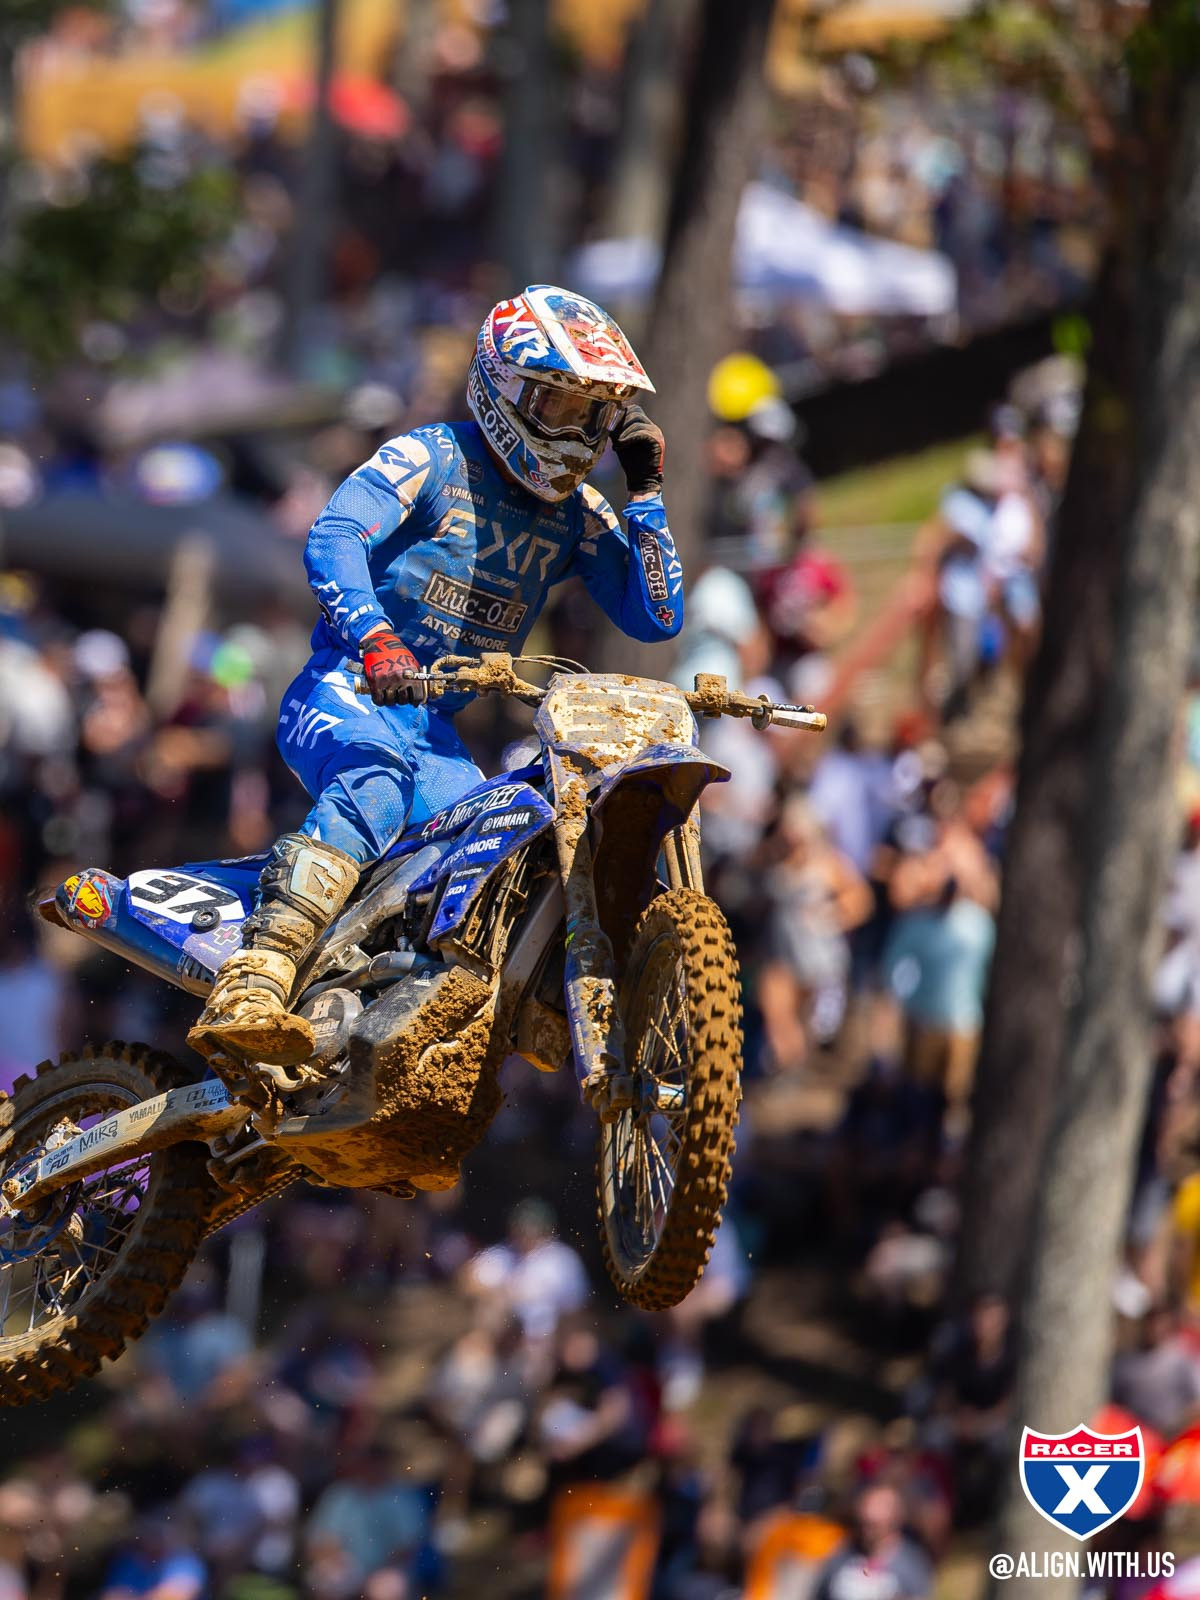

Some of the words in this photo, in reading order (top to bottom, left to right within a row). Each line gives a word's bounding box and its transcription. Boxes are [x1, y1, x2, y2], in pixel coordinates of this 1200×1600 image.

[451, 486, 485, 506] YAMAHA
[432, 507, 560, 582] FXR
[430, 580, 525, 629] Muc-Off
[370, 655, 416, 677] FXR
[492, 812, 530, 829] YAMAHA
